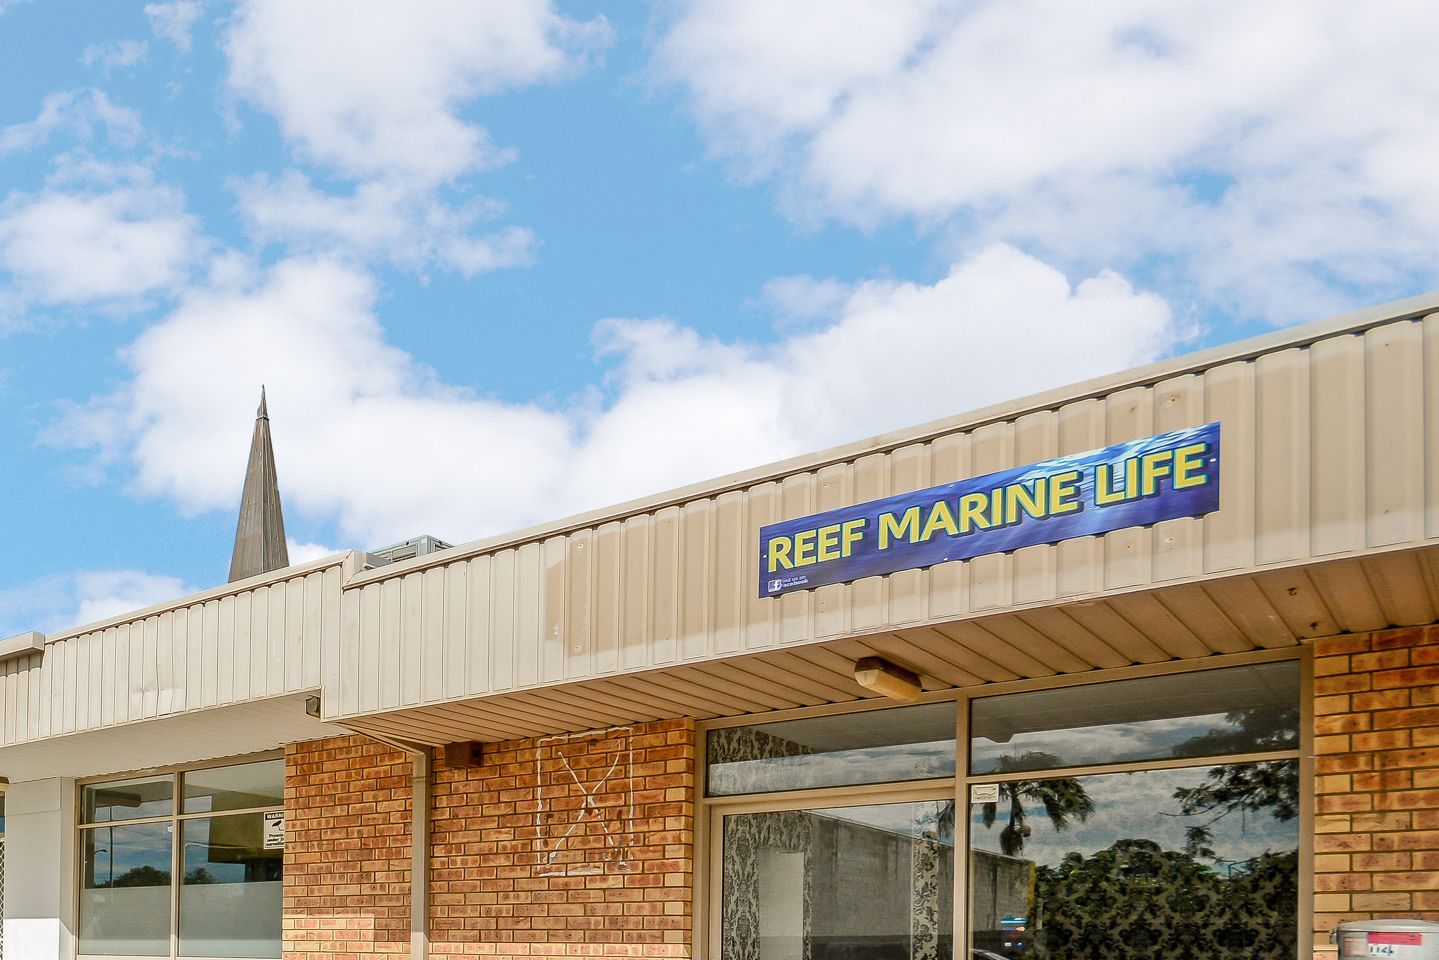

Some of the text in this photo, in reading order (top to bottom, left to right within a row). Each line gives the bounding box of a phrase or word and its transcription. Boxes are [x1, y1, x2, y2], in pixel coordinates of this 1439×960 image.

[767, 442, 1209, 573] REEF MARINE LIFE
